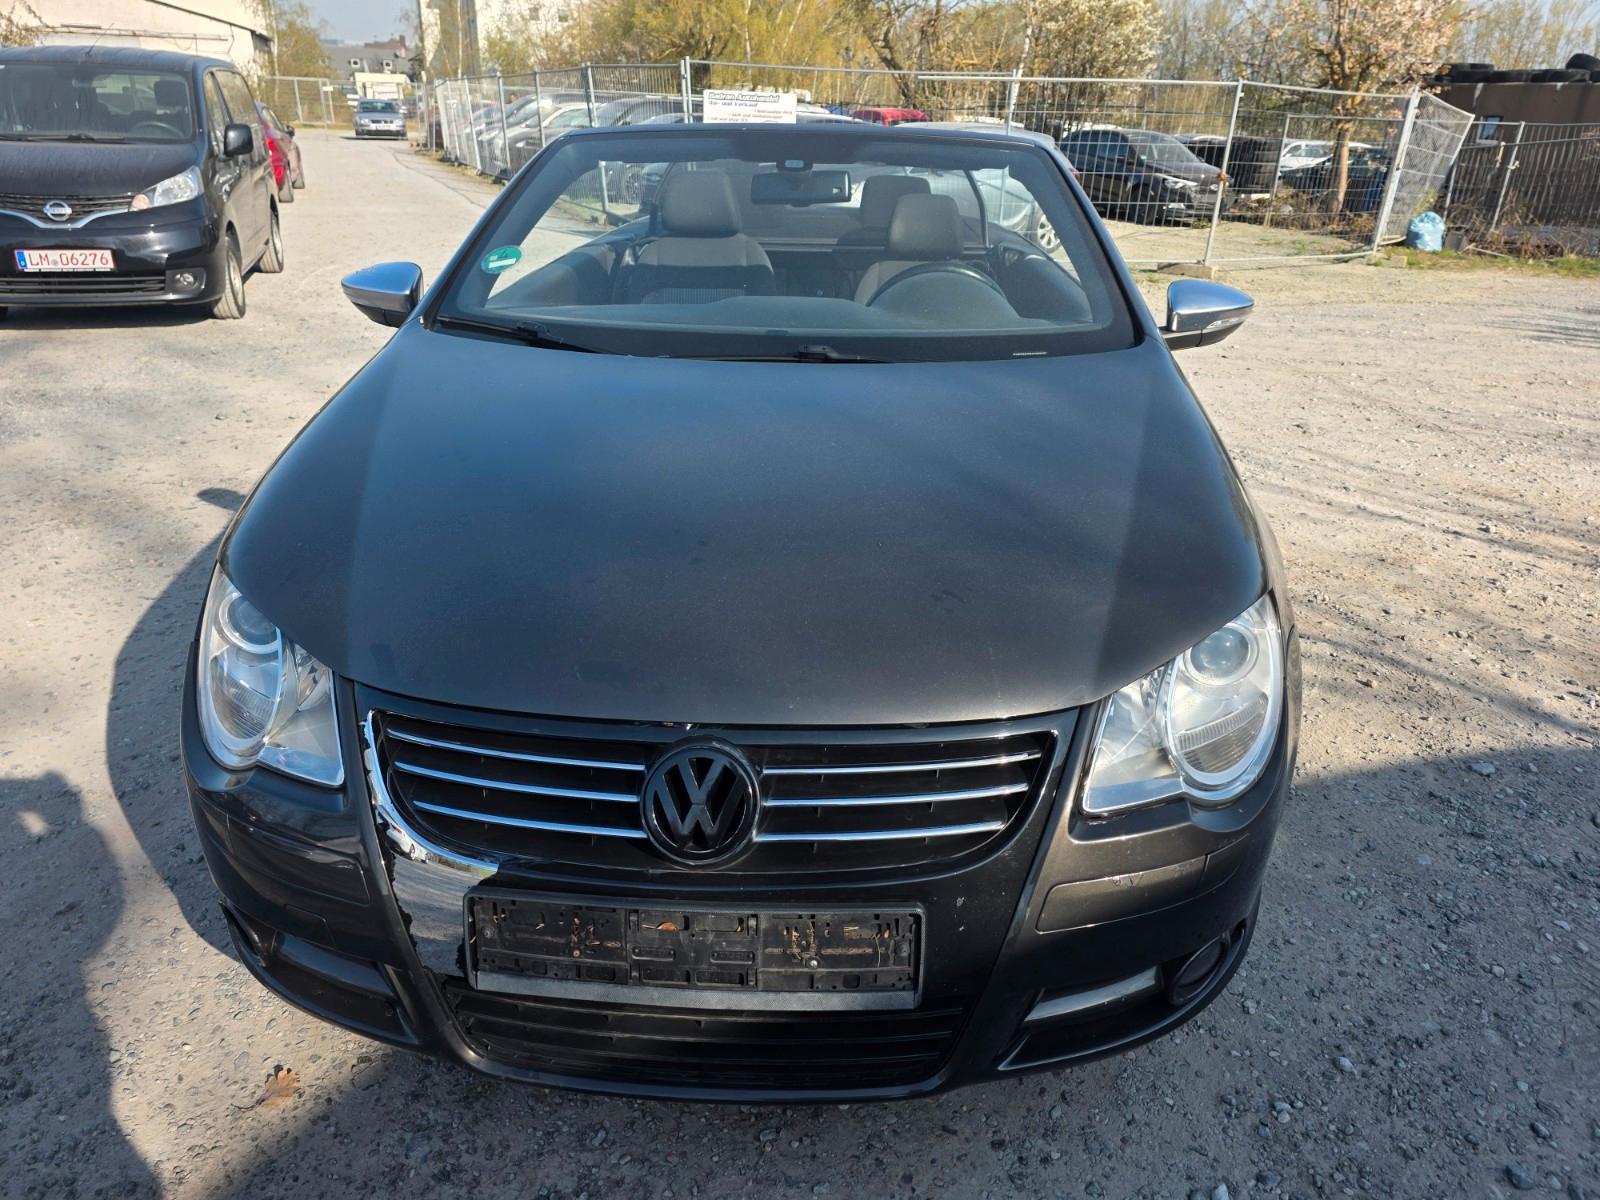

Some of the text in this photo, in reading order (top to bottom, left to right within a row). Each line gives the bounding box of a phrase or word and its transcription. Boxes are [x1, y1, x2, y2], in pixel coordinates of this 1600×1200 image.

[28, 252, 109, 266] LM 06276
[647, 748, 752, 857] VW
